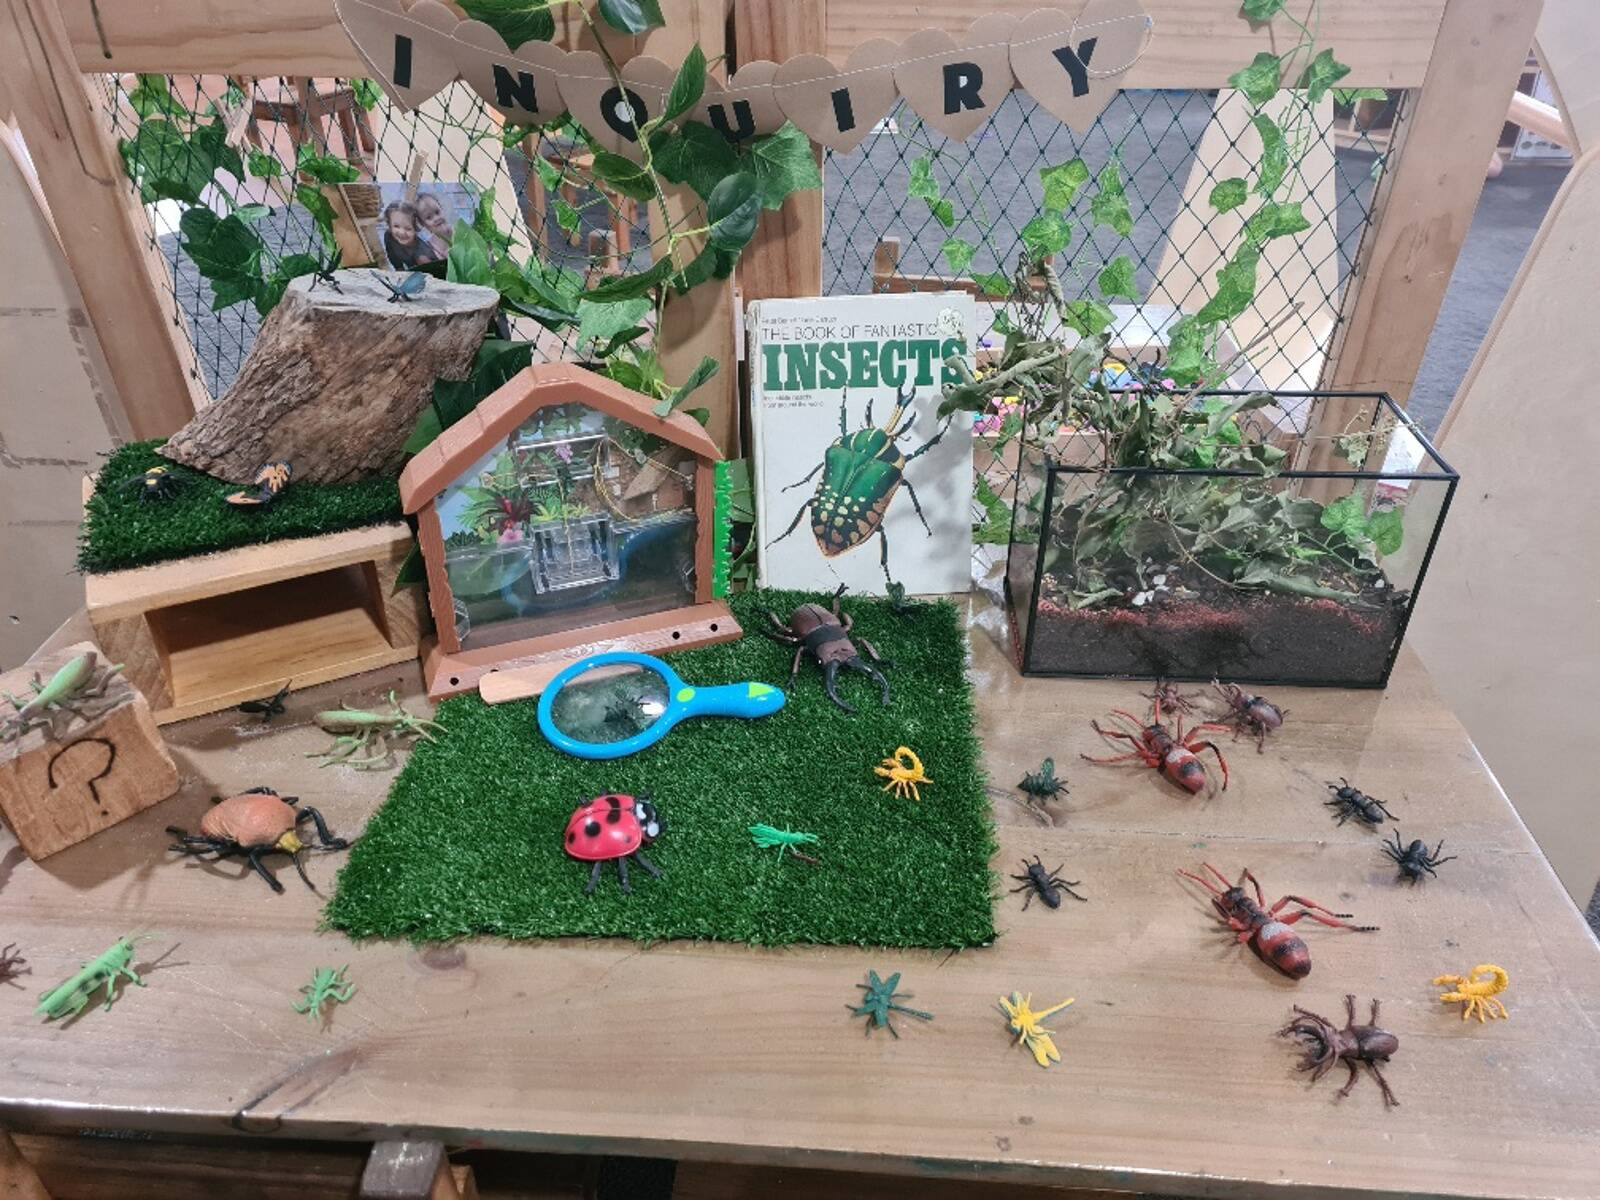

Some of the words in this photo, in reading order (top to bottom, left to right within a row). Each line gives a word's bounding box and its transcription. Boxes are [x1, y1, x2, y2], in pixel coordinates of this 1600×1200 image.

[761, 327, 790, 341] THE
[794, 325, 837, 341] BOOK
[841, 323, 861, 339] OF
[864, 322, 938, 338] FANTASTIC
[762, 337, 968, 391] INSECTS
[48, 738, 117, 816] ?
